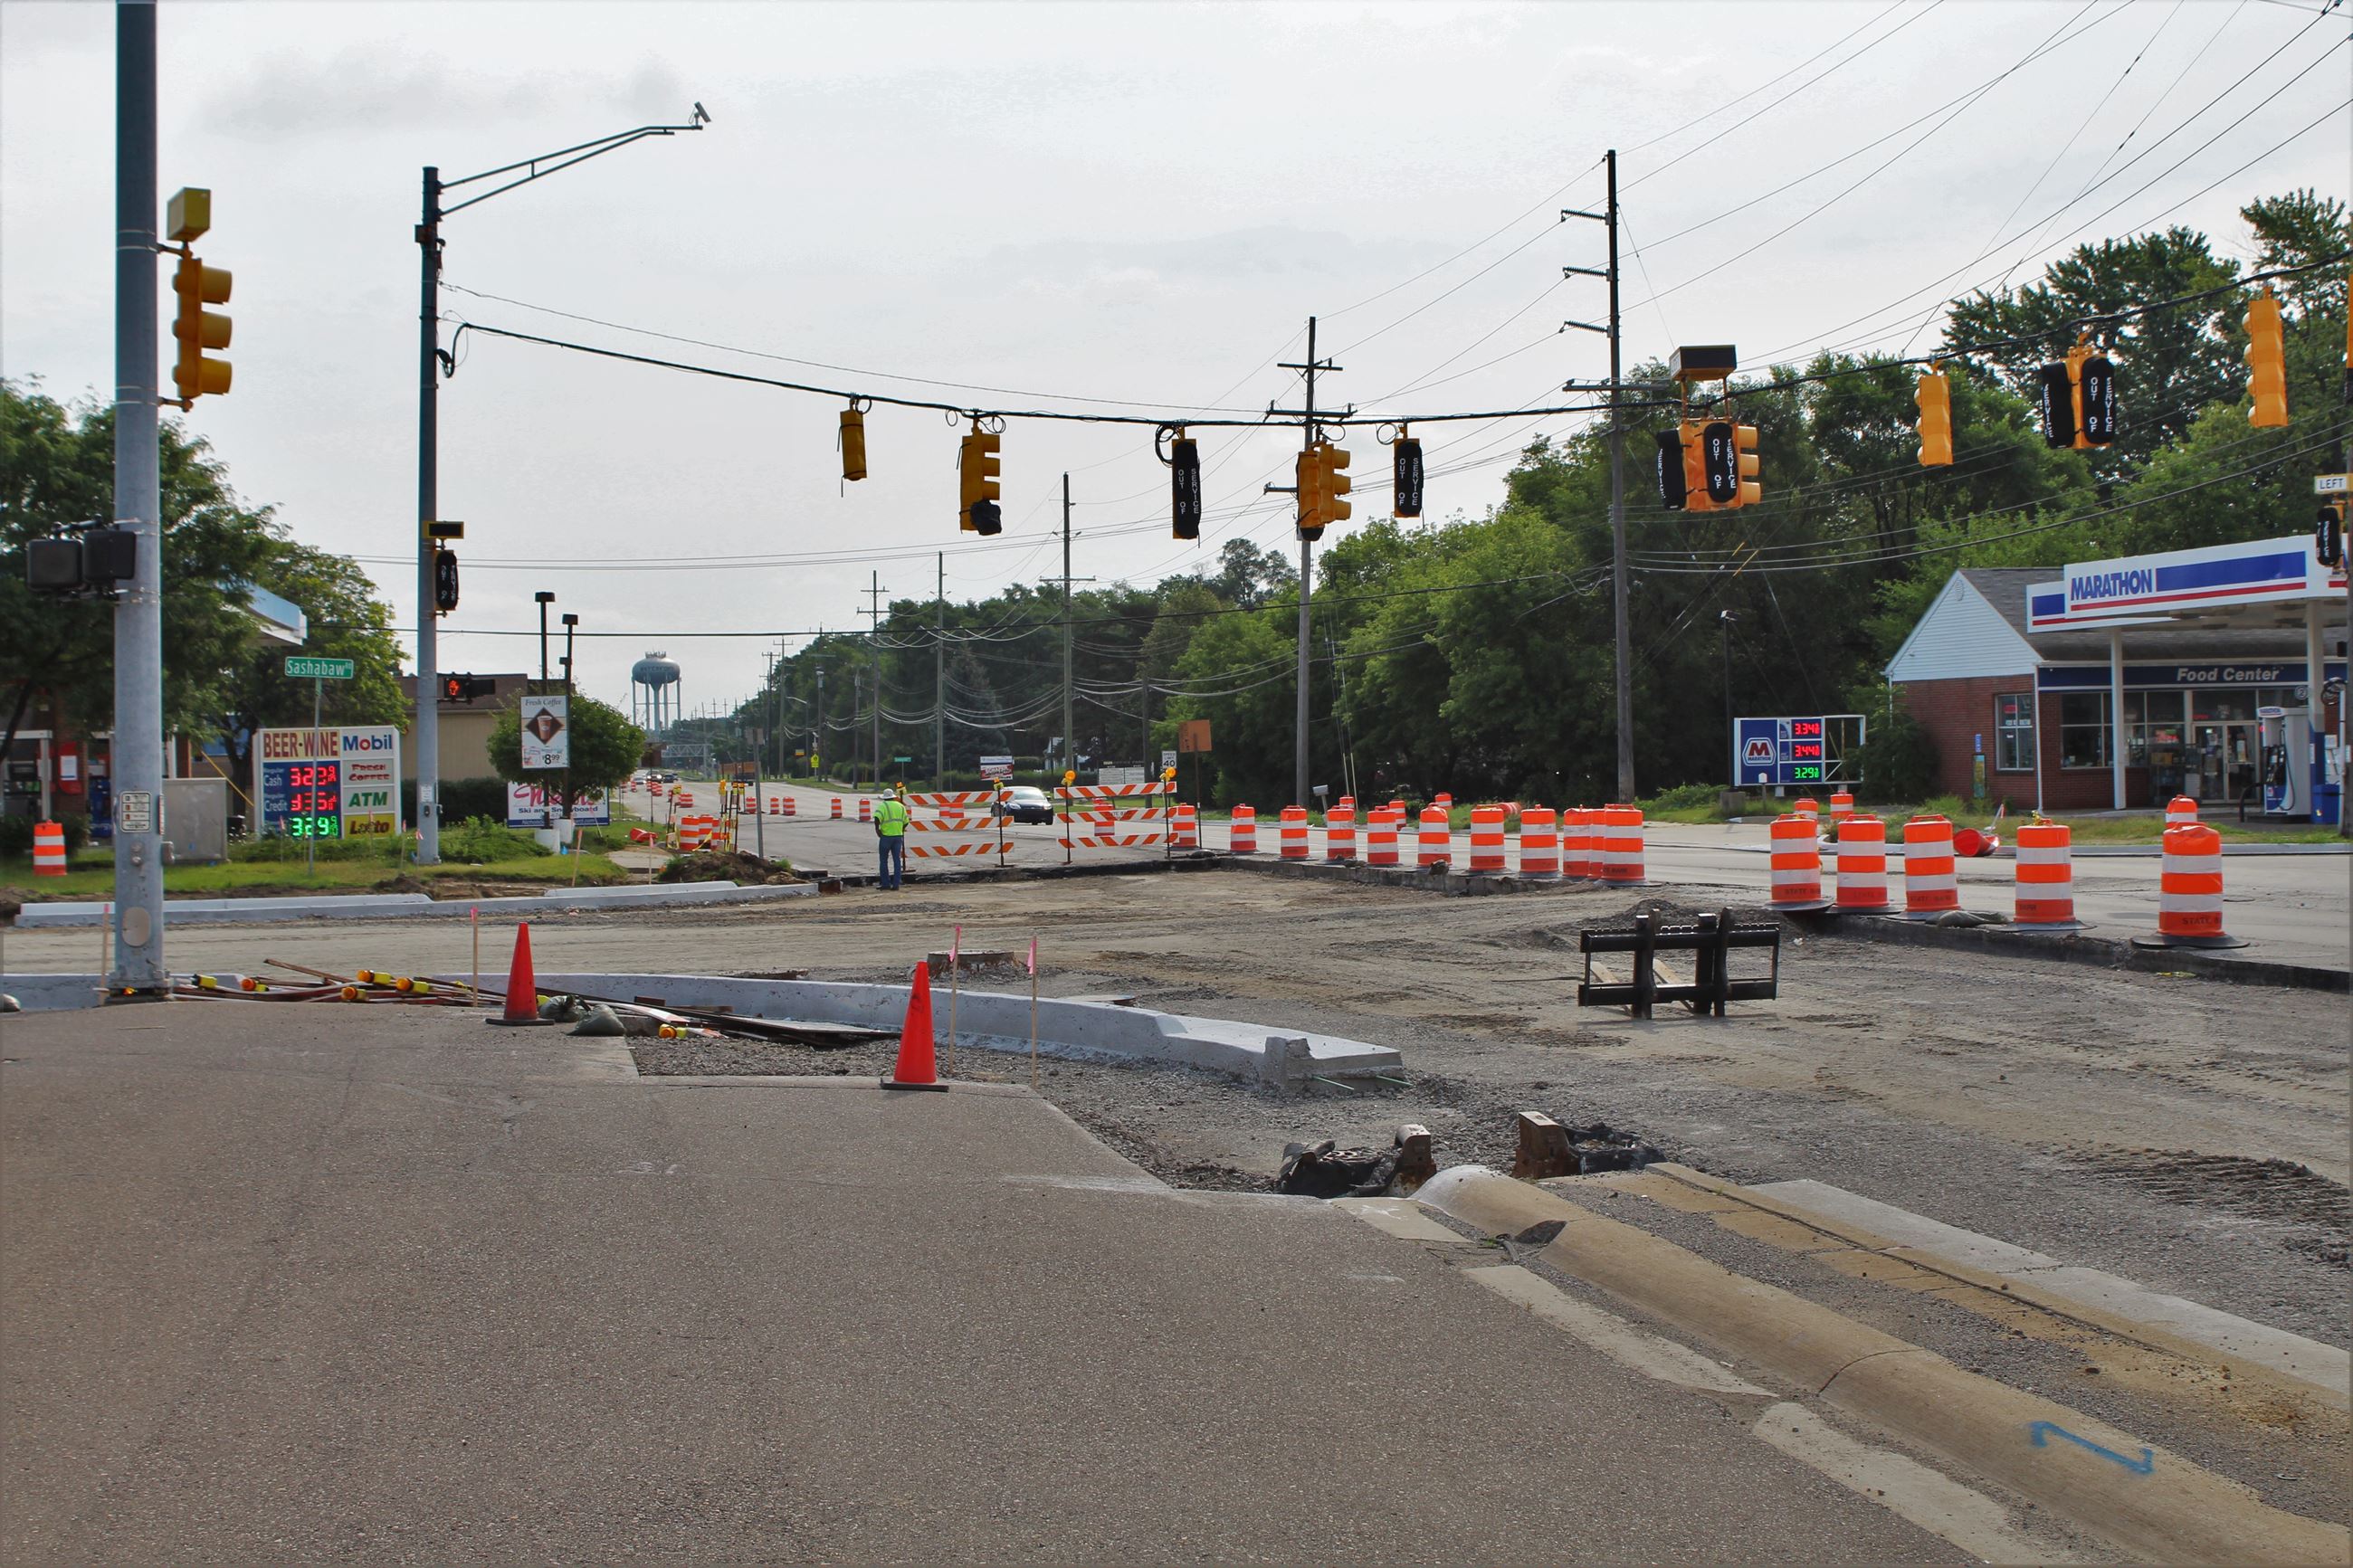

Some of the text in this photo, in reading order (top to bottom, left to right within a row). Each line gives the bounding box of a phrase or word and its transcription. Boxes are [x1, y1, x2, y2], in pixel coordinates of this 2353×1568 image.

[2089, 376, 2098, 432] OUT OF
[2105, 376, 2113, 432] SERVICE
[1712, 438, 1722, 489] OUT OF
[1727, 438, 1737, 489] SERVICE
[1191, 468, 1199, 514] SERVICE
[2320, 478, 2344, 489] LEFT
[1398, 492, 1405, 506] OF
[1179, 501, 1186, 514] OF
[2071, 569, 2152, 602] MARATHON
[287, 659, 346, 676] Sashabaw
[2177, 667, 2280, 682] Food Center
[263, 733, 299, 758] BEER
[343, 734, 392, 751] Mobil
[1163, 759, 1176, 767] 40
[264, 774, 282, 786] Cash
[264, 800, 288, 812] Credit
[348, 792, 387, 807] ATM
[519, 805, 531, 813] Ski
